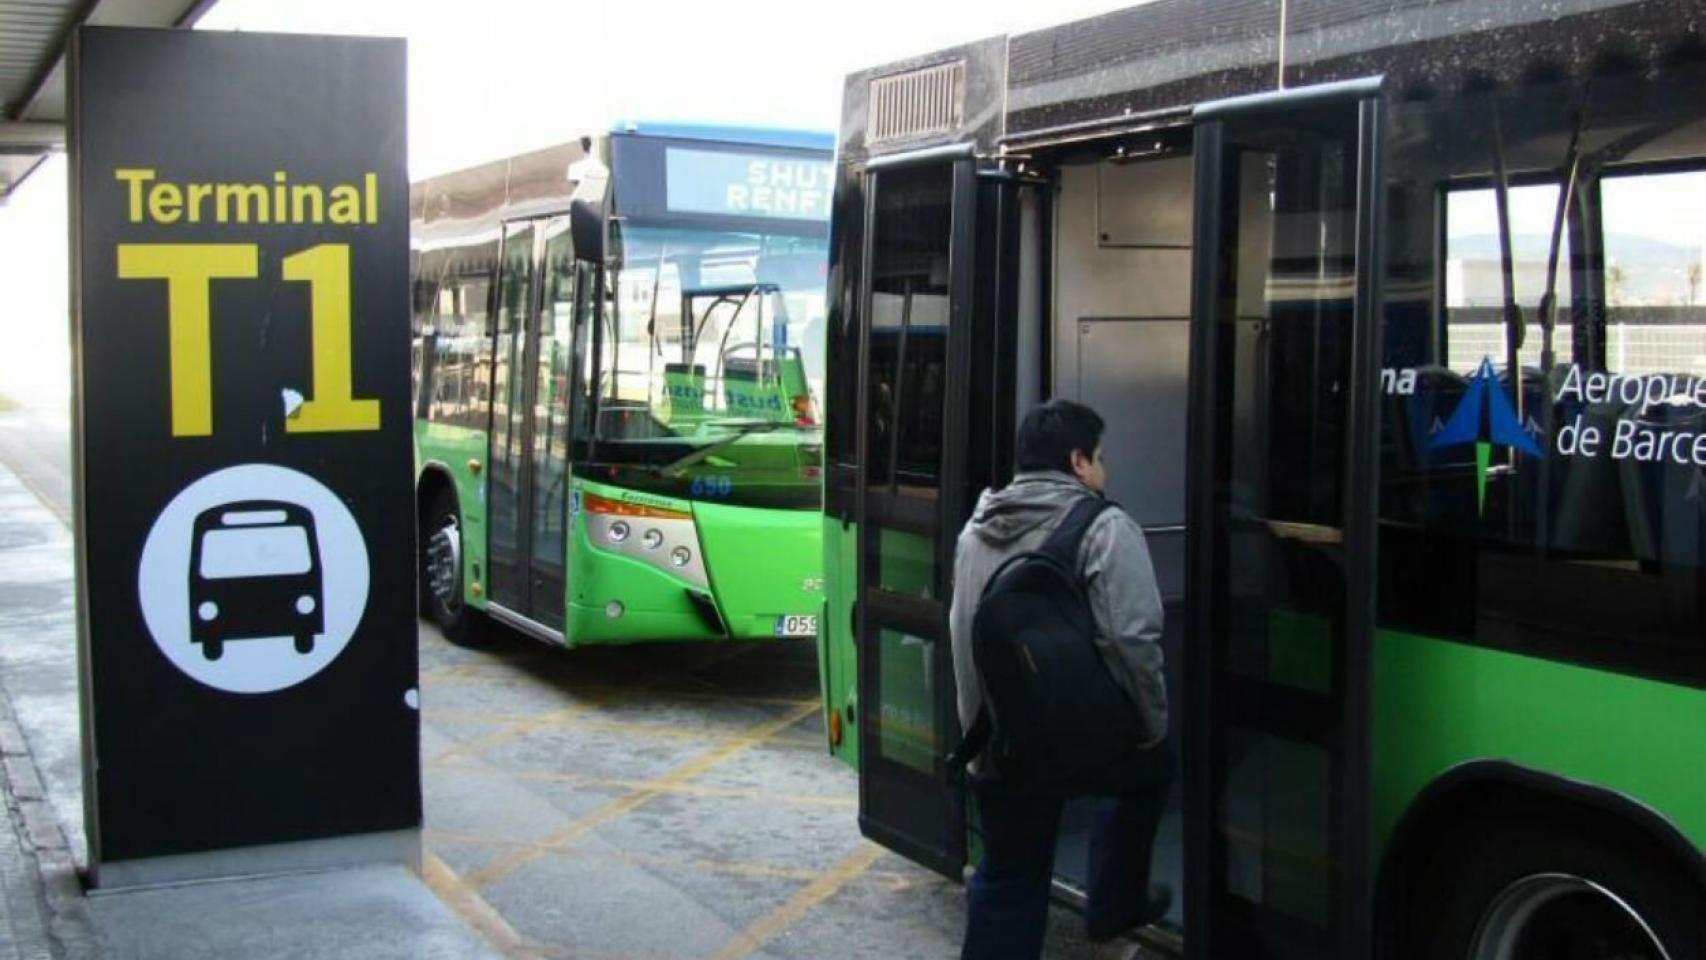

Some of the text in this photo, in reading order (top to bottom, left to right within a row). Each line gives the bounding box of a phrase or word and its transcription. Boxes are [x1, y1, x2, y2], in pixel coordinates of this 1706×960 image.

[115, 168, 378, 224] Terminal
[117, 243, 381, 438] T1
[1552, 363, 1706, 416] Aeropue
[1557, 414, 1706, 465] de Barce
